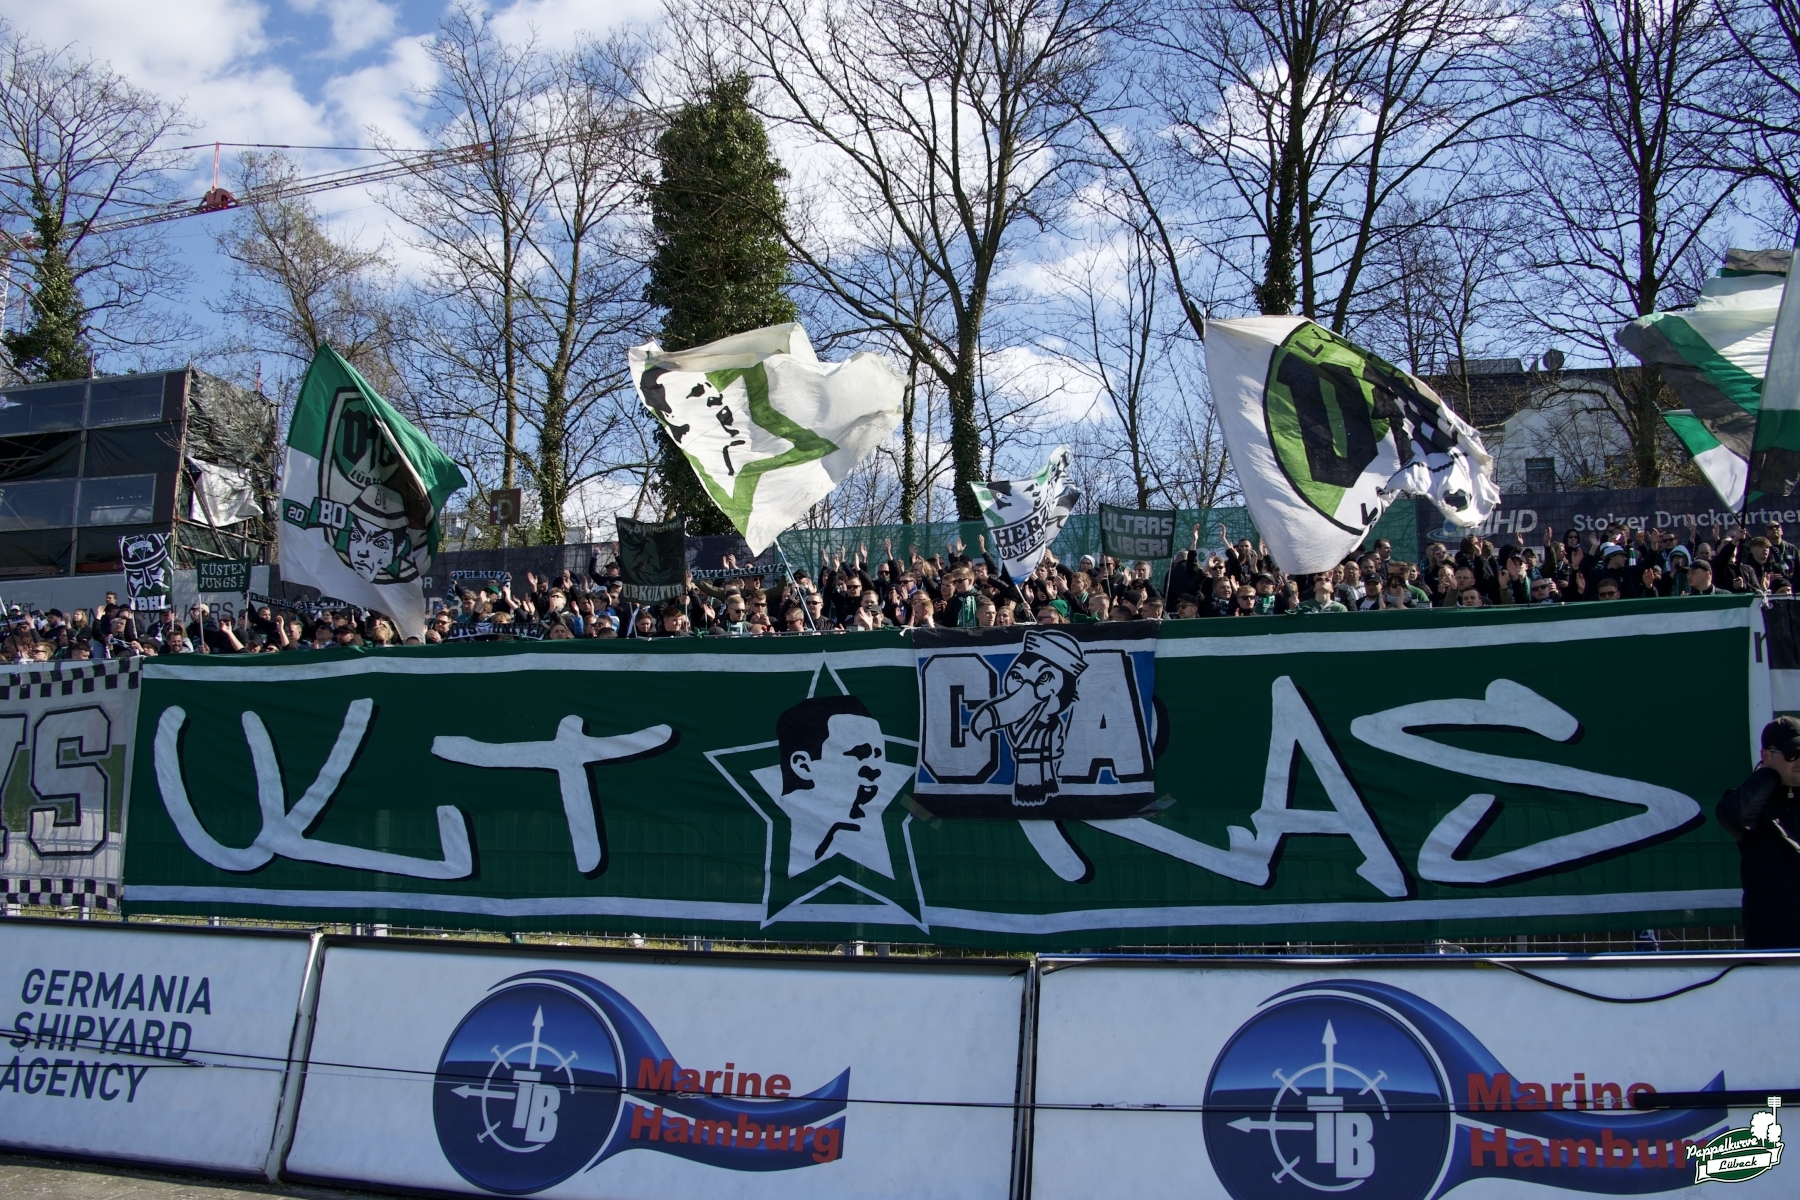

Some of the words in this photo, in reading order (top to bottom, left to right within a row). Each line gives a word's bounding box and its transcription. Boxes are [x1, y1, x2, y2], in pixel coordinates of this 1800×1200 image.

[1102, 511, 1174, 536] ULTRAS
[1573, 513, 1649, 532] Stolzer
[1107, 534, 1168, 557] LIBERI
[200, 576, 237, 588] JUNGS
[201, 562, 247, 576] KÜSTEN
[21, 967, 212, 1016] GERMANIA
[9, 1011, 193, 1061] SHIPYARD
[0, 1055, 151, 1103] AGENCY
[636, 1057, 792, 1100] Marine
[629, 1105, 841, 1165] Hamburg
[1469, 1128, 1709, 1170] Hambur
